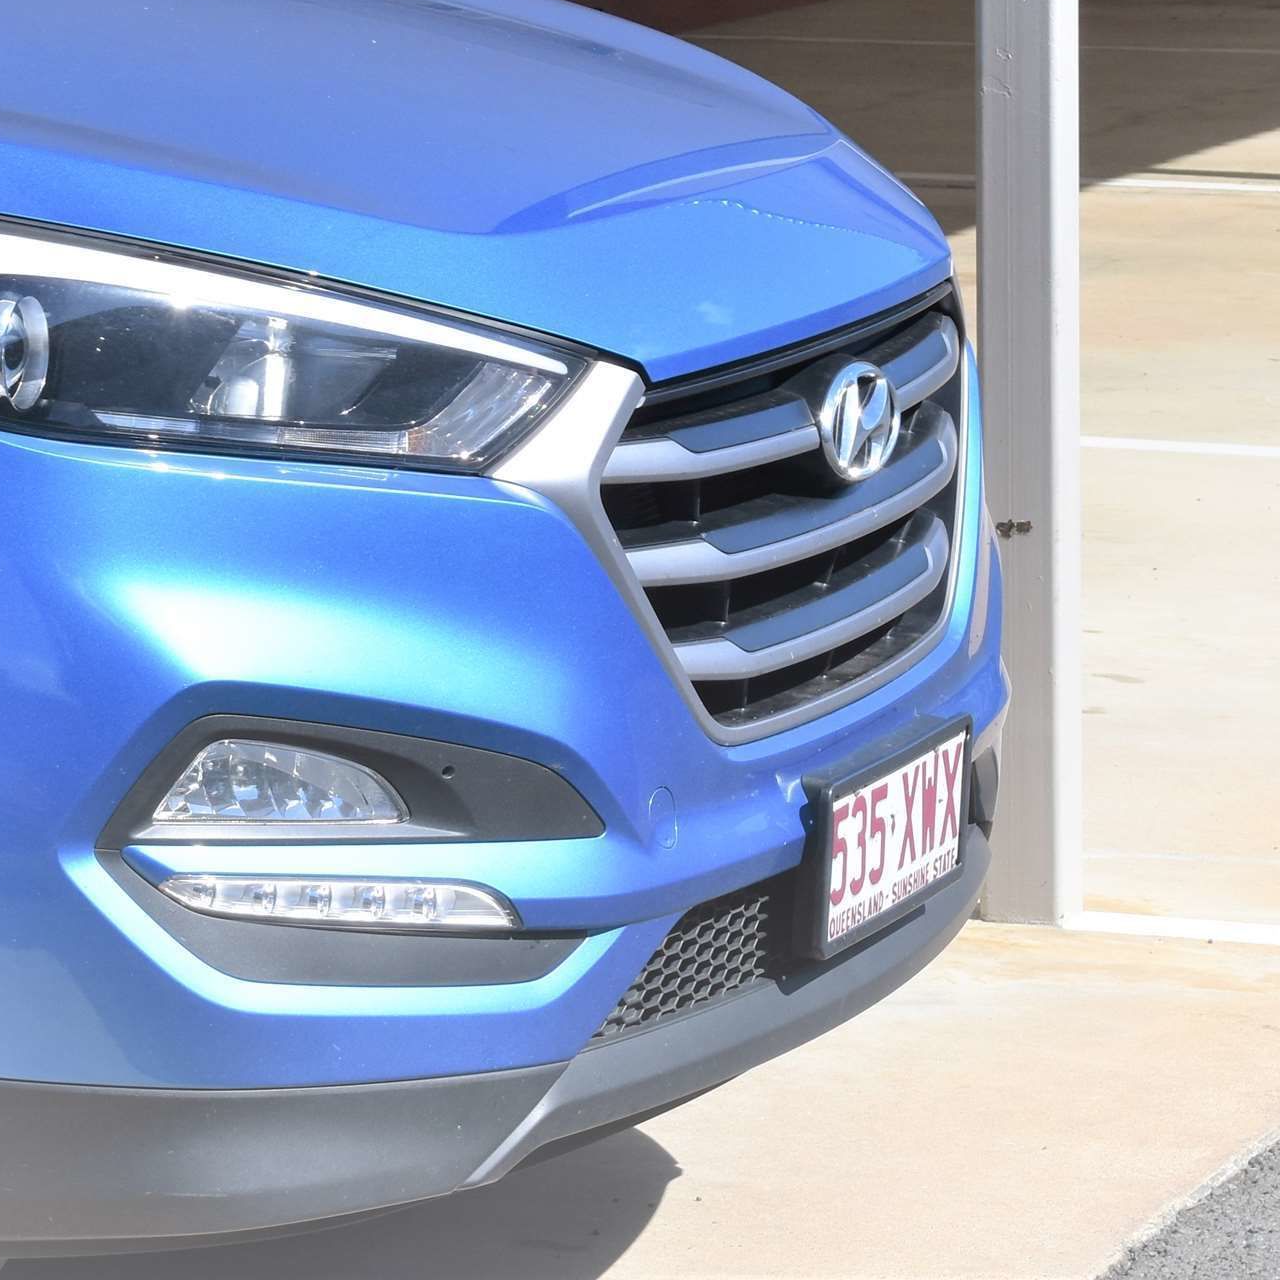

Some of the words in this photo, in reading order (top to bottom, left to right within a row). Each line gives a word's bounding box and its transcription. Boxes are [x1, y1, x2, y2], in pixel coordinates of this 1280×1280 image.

[829, 783, 889, 907] 535
[899, 742, 963, 871] XWX
[829, 894, 885, 939] QUEENSLAND
[891, 864, 930, 904] SUNSHINE
[933, 847, 956, 878] STATE
